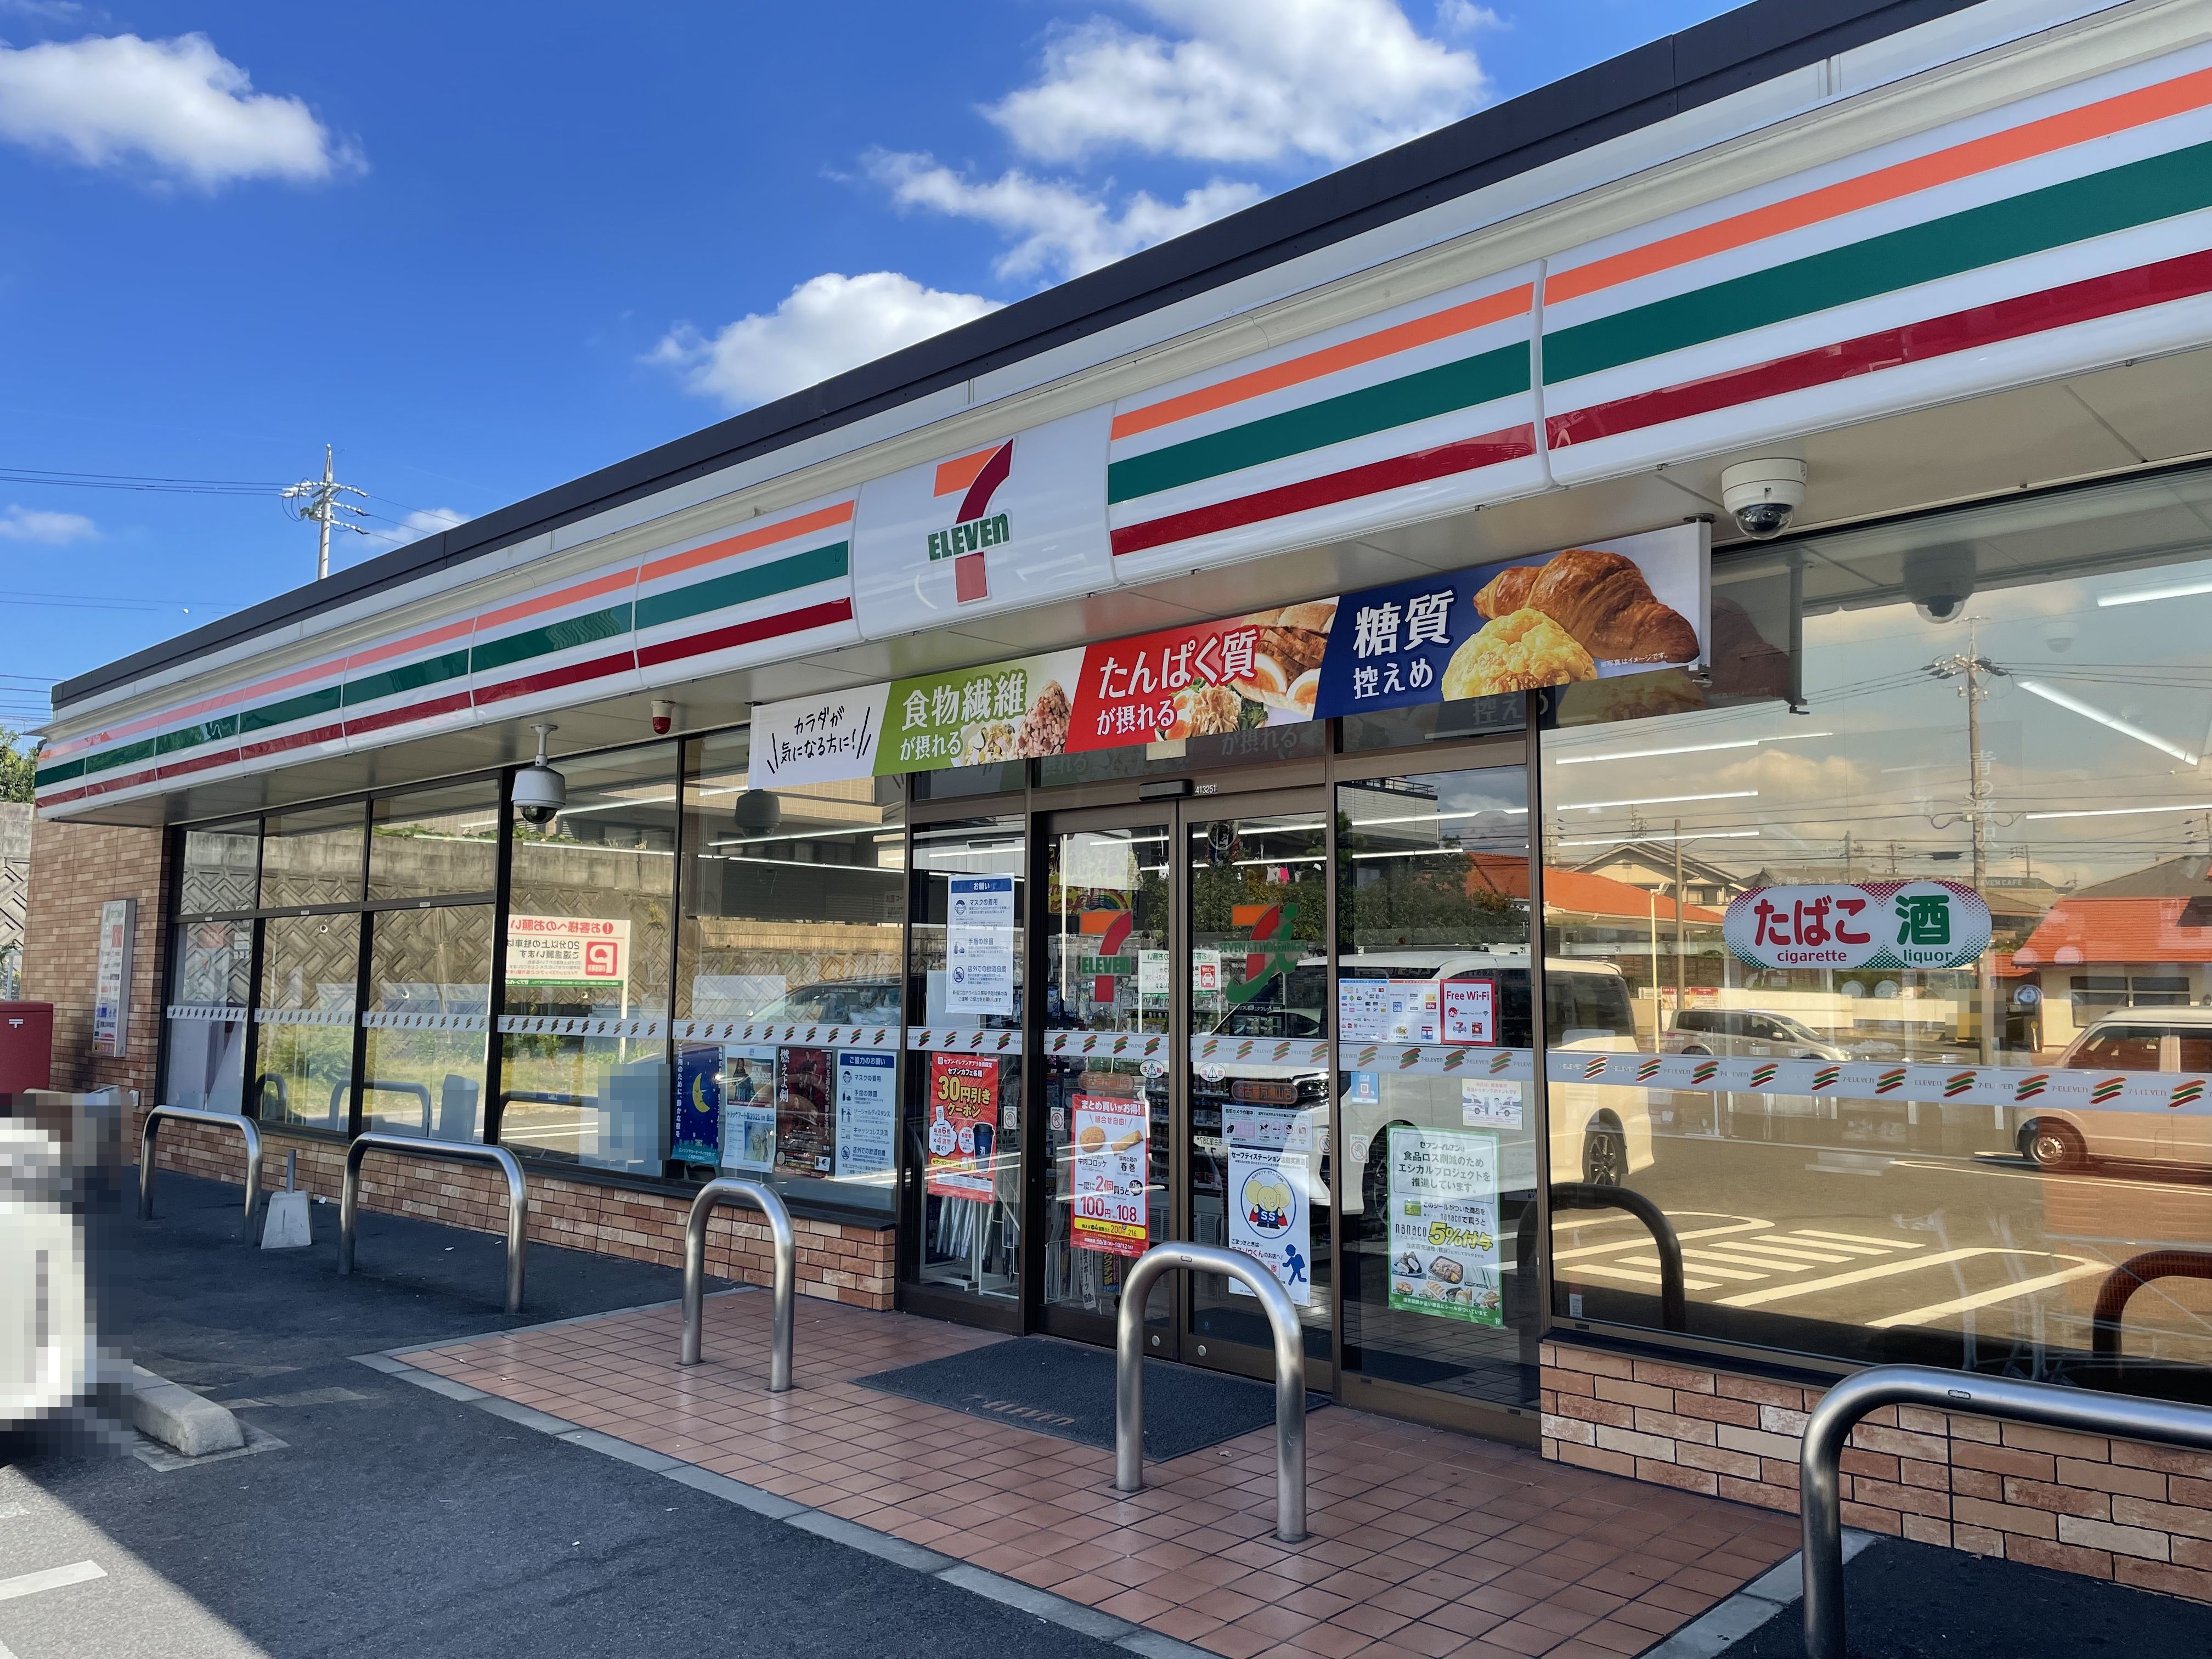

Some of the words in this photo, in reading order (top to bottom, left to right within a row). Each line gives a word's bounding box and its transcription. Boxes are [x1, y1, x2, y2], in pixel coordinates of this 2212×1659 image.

[1352, 589, 1456, 659] 糖質
[1098, 627, 1257, 699] たんぱく質
[1600, 652, 1668, 668] ※写真はイメージです。
[1351, 658, 1434, 701] 控えめ
[901, 668, 1025, 731] 食物繊維
[794, 706, 845, 735] カラダが
[1096, 694, 1176, 736] が摂れる
[899, 730, 962, 763] が摂れる
[1195, 785, 1216, 794] 413251
[1754, 895, 1871, 946] たばこ
[1895, 895, 1950, 945] 酒
[1777, 950, 1847, 964] cigarette
[1904, 949, 1954, 964] liquor
[1446, 991, 1465, 1000] Free
[1466, 991, 1489, 1001] Wi-Fi
[849, 1056, 885, 1065] ご協力のお願い
[779, 1048, 790, 1103] 燃えよ剣
[938, 1075, 991, 1104] 30円引き
[947, 1102, 981, 1118] クーポン
[1077, 1158, 1107, 1167] 牛肉コロッケ
[1404, 1151, 1484, 1168] 食品ロス削減のため
[1251, 1170, 1266, 1180] SAFETY
[1267, 1170, 1284, 1183] STATION
[1398, 1164, 1491, 1182] エシカルプロジェクトを
[1412, 1177, 1476, 1194] 推進しています。
[1261, 1211, 1276, 1221] SS
[1423, 1202, 1486, 1215] このシールがついた商品を
[1395, 1223, 1427, 1237] nanaco
